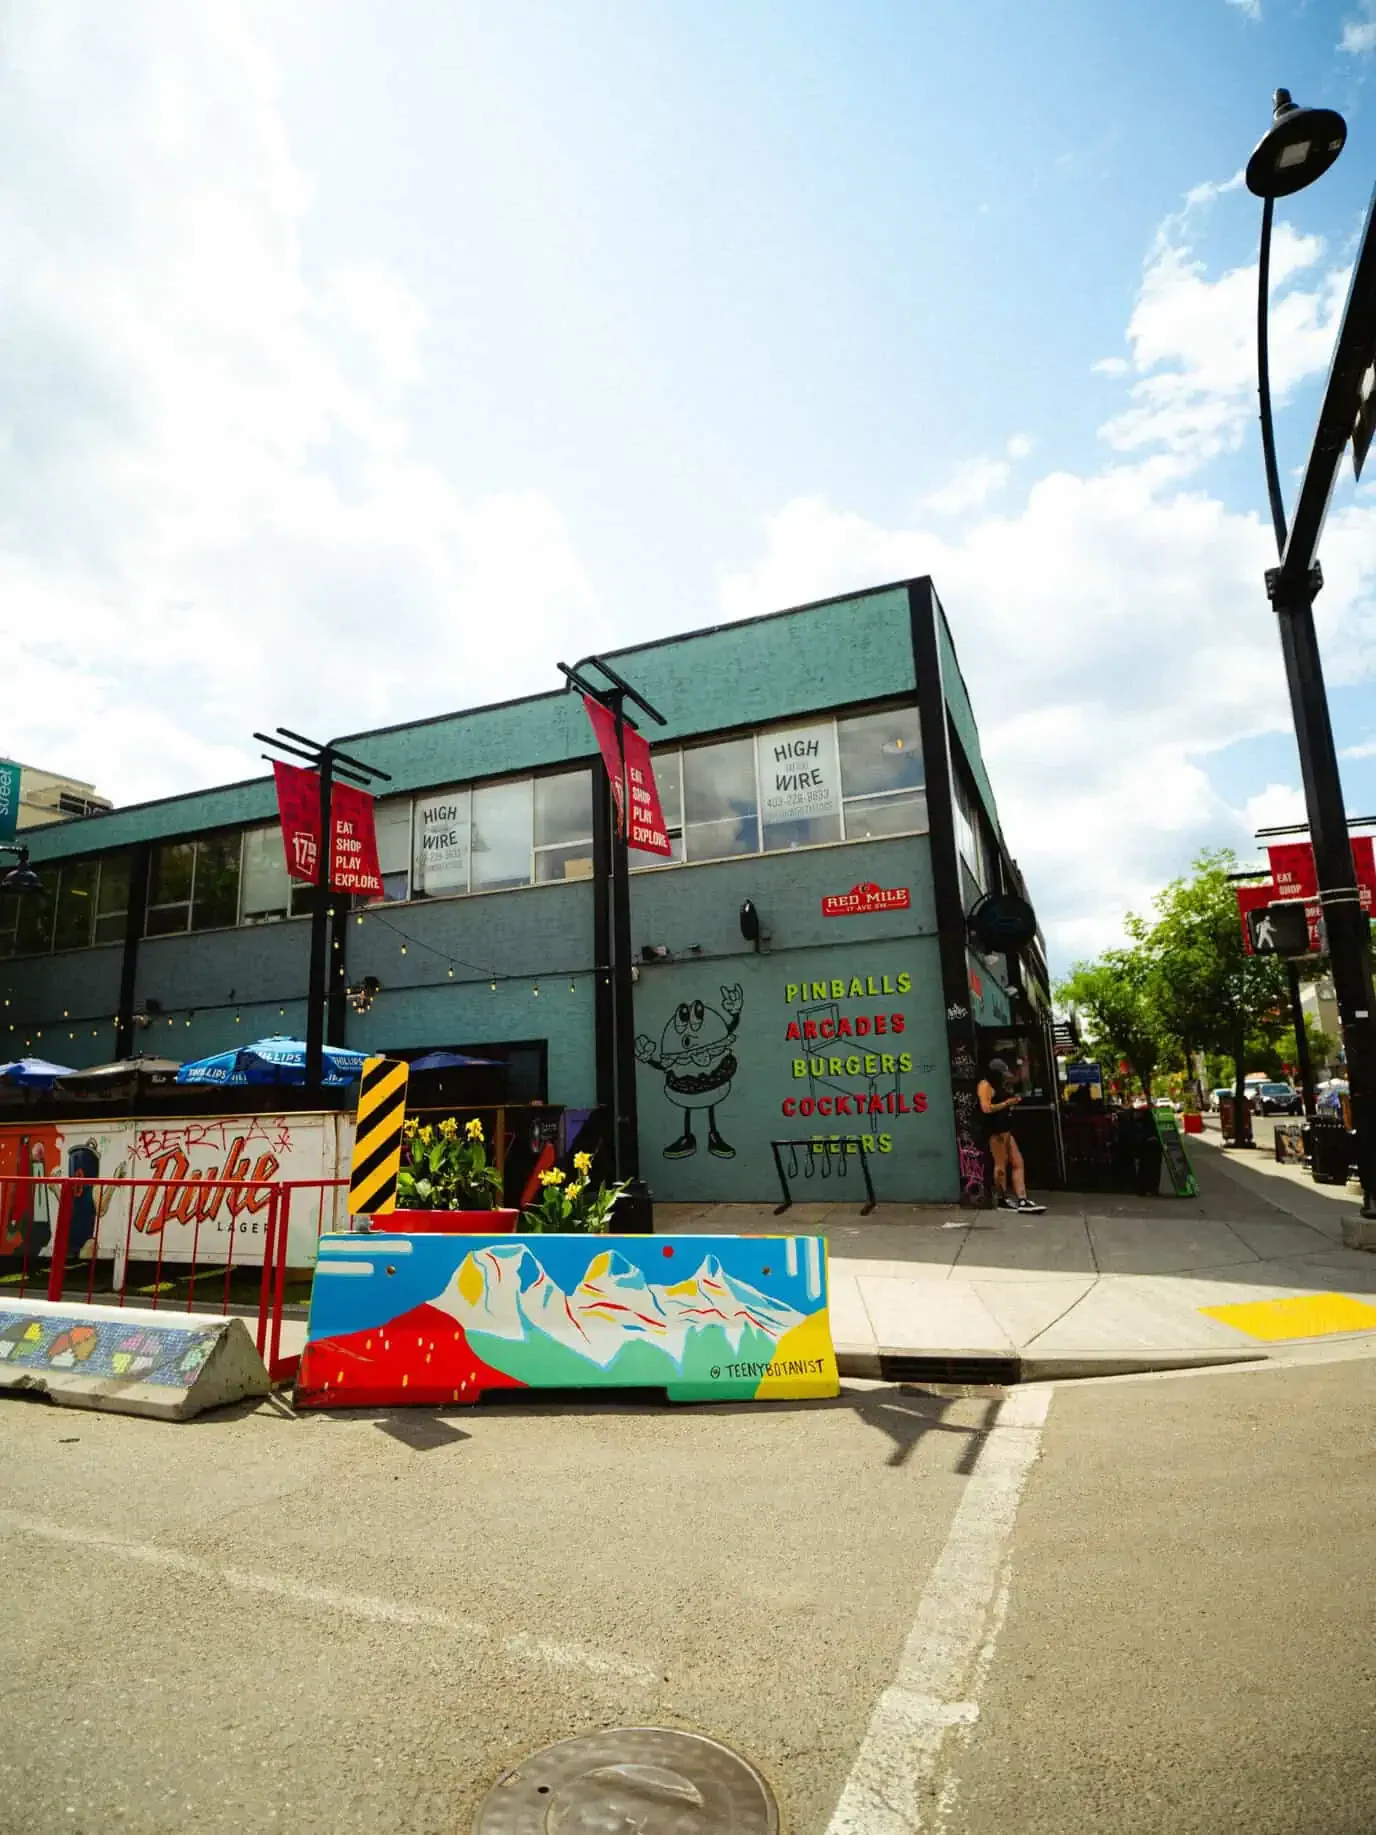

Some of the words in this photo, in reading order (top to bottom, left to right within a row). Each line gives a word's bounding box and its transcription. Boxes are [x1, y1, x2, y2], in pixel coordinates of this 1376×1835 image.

[774, 740, 819, 762] HIGH
[776, 768, 824, 791] WIRE
[424, 806, 457, 825] HIGH
[336, 820, 354, 835] EAT
[336, 838, 361, 853] SHOP
[424, 830, 458, 849] WIRE
[335, 856, 361, 870] PLAY
[335, 873, 380, 890] EXPLORE
[1277, 872, 1292, 883] EAT
[827, 895, 859, 908] RED
[866, 889, 906, 903] MILE
[785, 972, 912, 1003] PINBALLS
[785, 1013, 906, 1041] ARCADES
[792, 1052, 913, 1079] BURGERS
[782, 1092, 929, 1117] COCKTAILS
[811, 1133, 893, 1153] BEERS
[134, 1136, 280, 1234] Duke
[725, 1358, 825, 1378] TEENYBOTANIST
